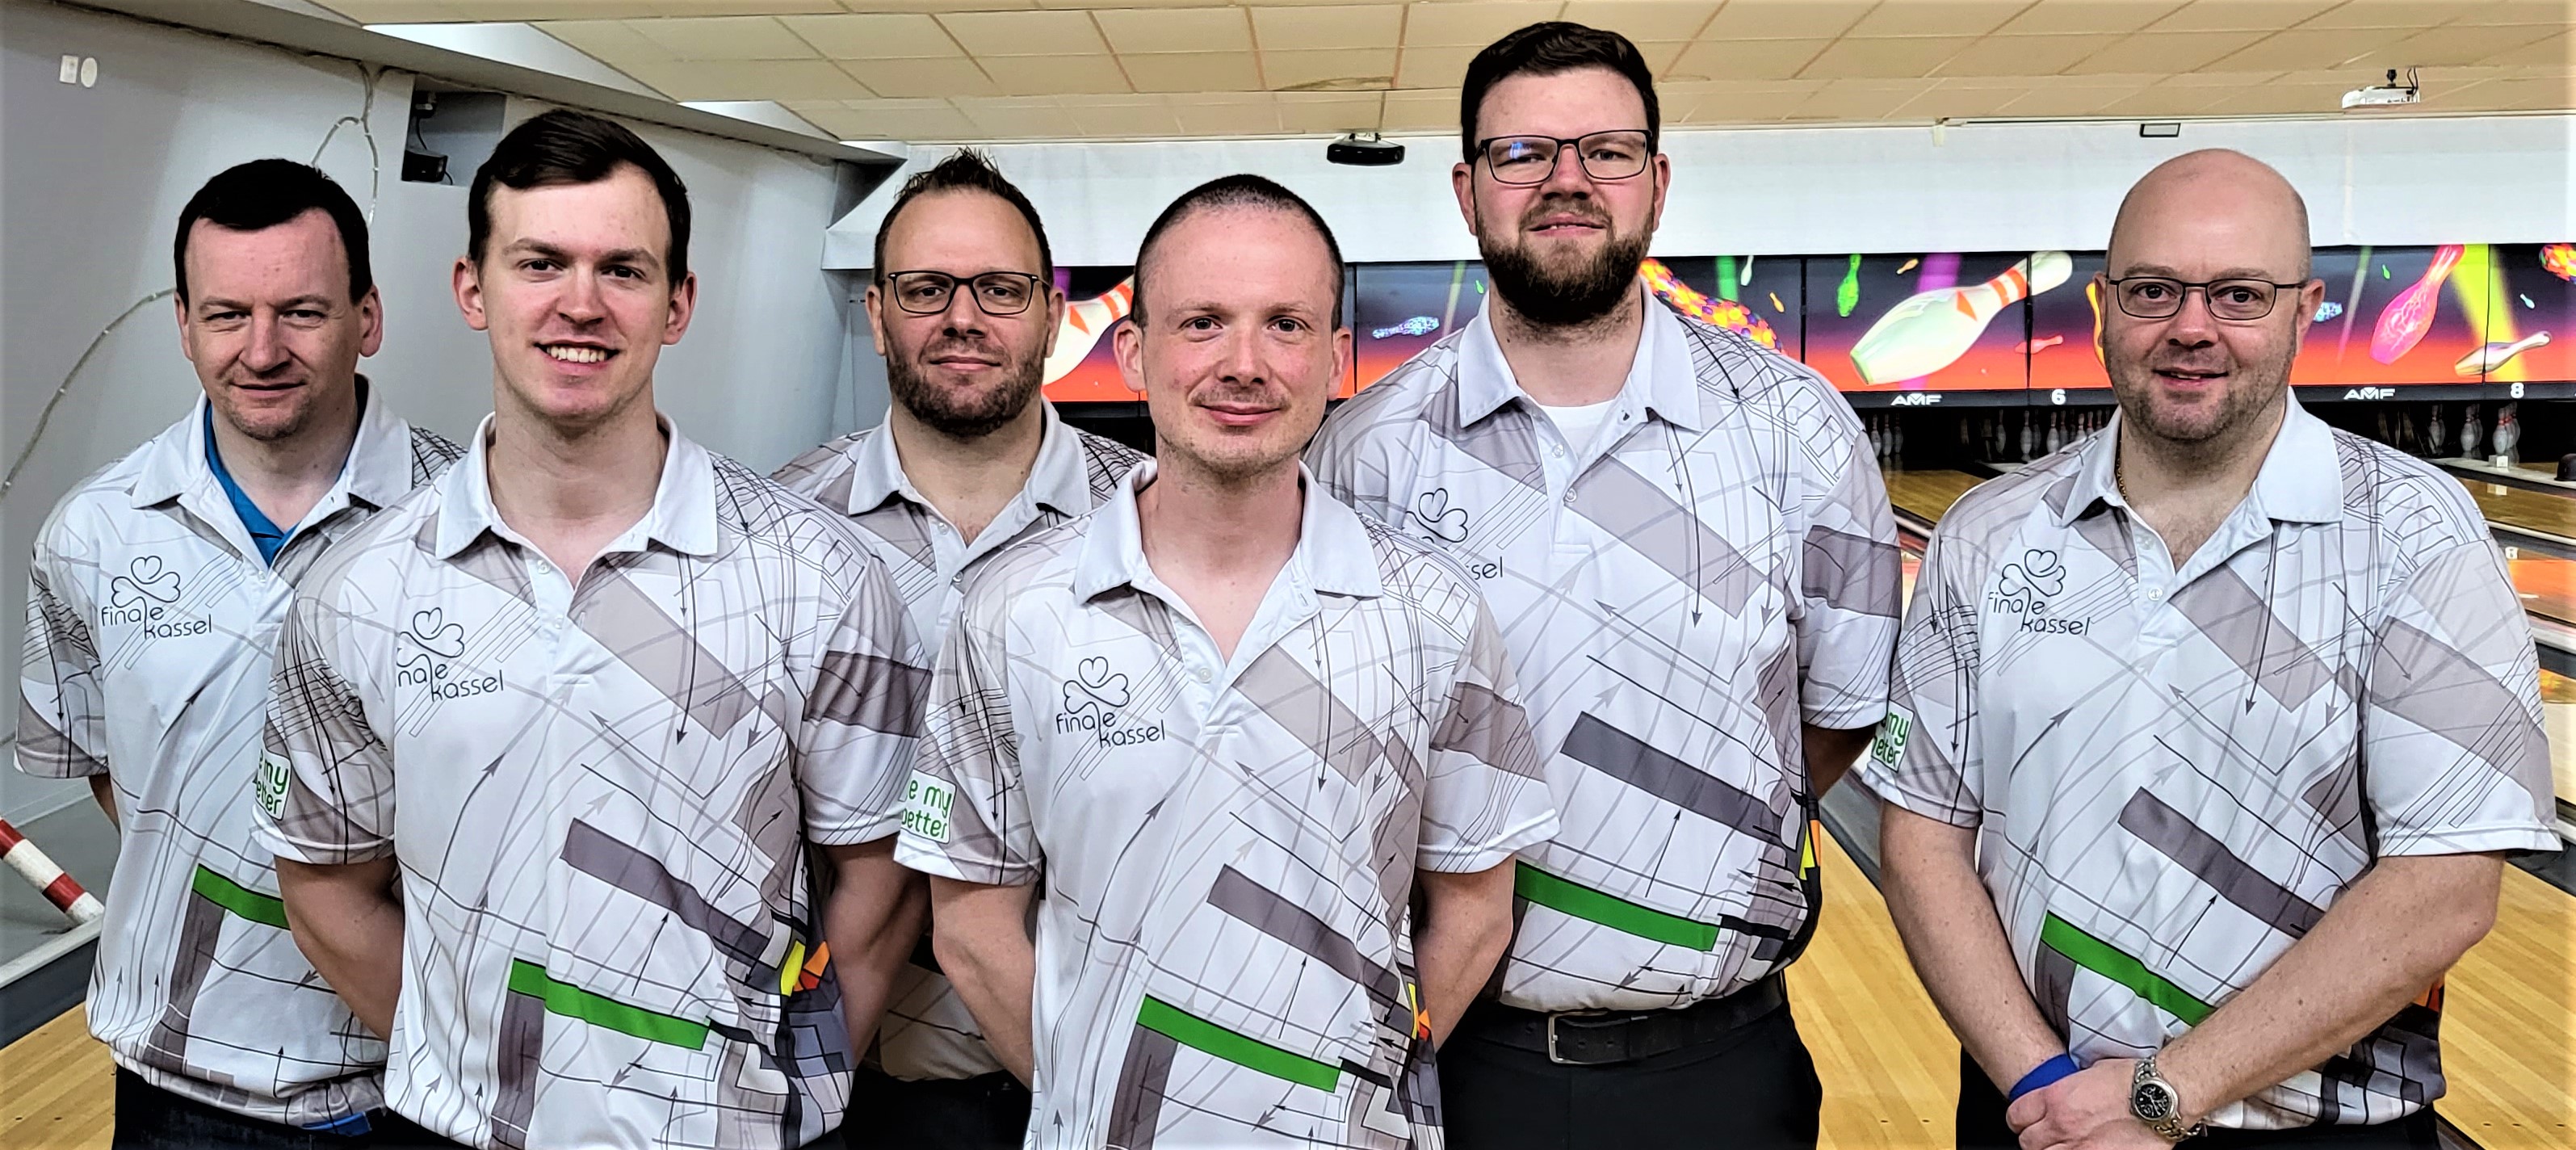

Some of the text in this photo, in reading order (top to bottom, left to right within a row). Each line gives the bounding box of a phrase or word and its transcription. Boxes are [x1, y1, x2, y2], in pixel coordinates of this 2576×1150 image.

[1890, 393, 1942, 405] AMF
[2051, 388, 2066, 405] 6
[2343, 387, 2396, 400] AMF
[2511, 383, 2524, 398] 8
[1466, 556, 1503, 581] sel
[101, 604, 165, 627] finale
[397, 663, 449, 687] nale
[1055, 712, 1117, 735] finale
[1886, 712, 1909, 747] my
[264, 759, 288, 795] my
[923, 786, 952, 819] my
